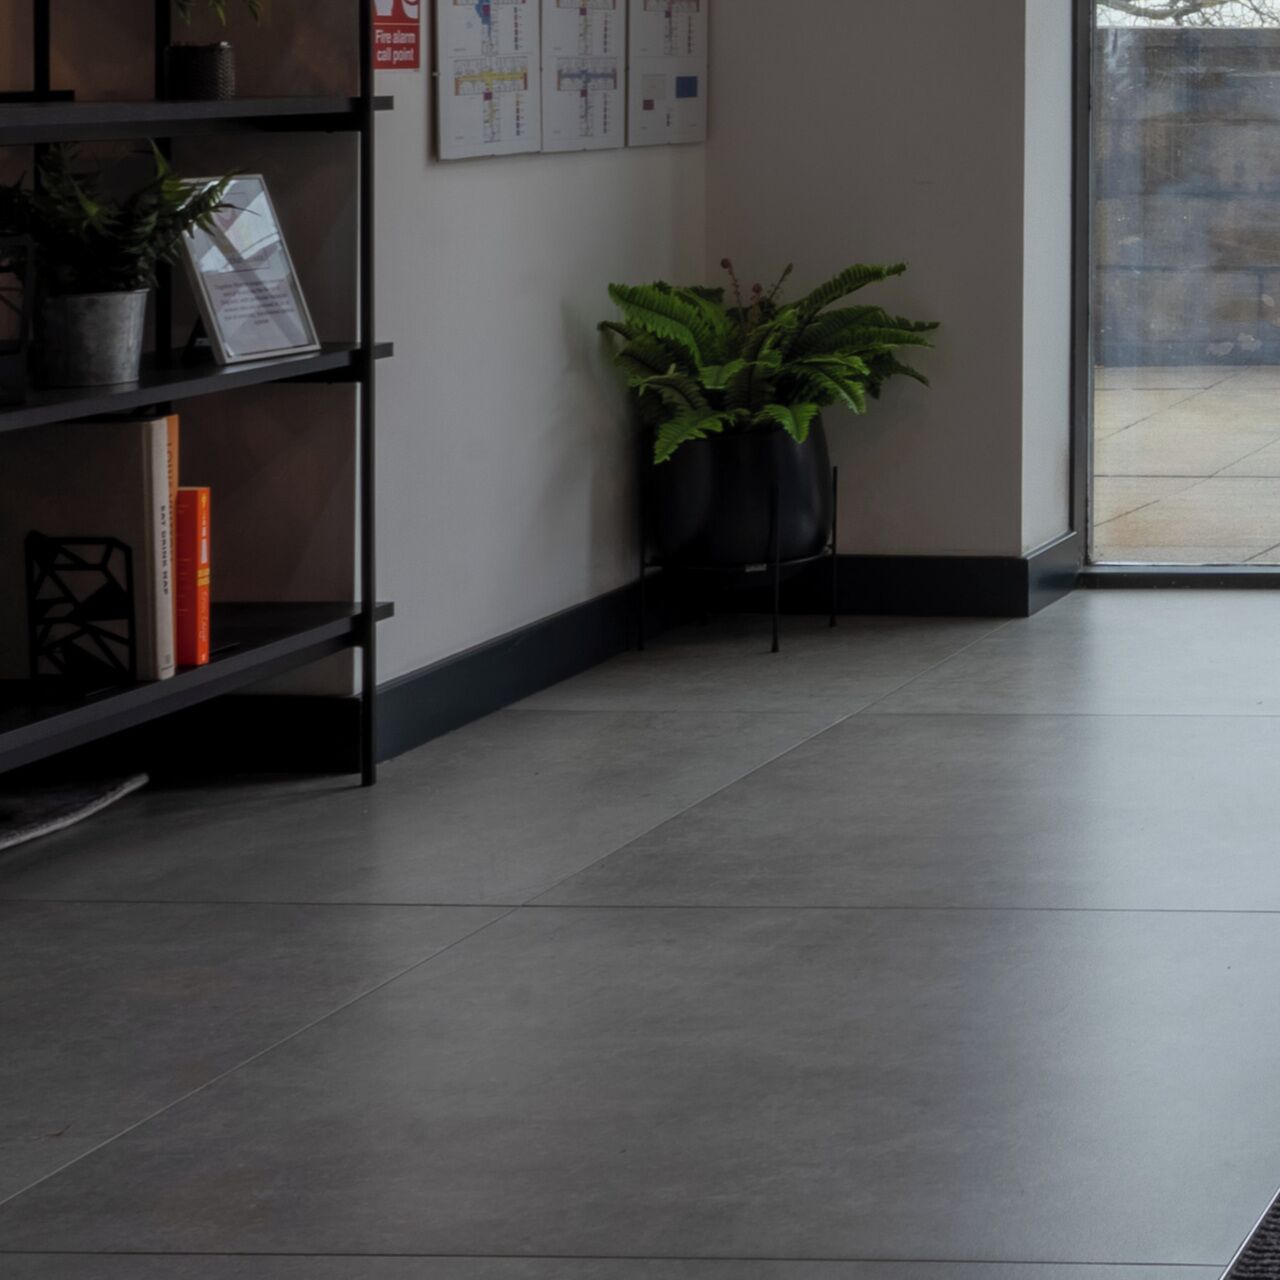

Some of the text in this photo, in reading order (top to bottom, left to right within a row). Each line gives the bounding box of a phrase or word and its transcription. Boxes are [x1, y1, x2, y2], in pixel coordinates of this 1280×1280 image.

[375, 29, 416, 44] Fire alarm
[377, 47, 414, 65] call point
